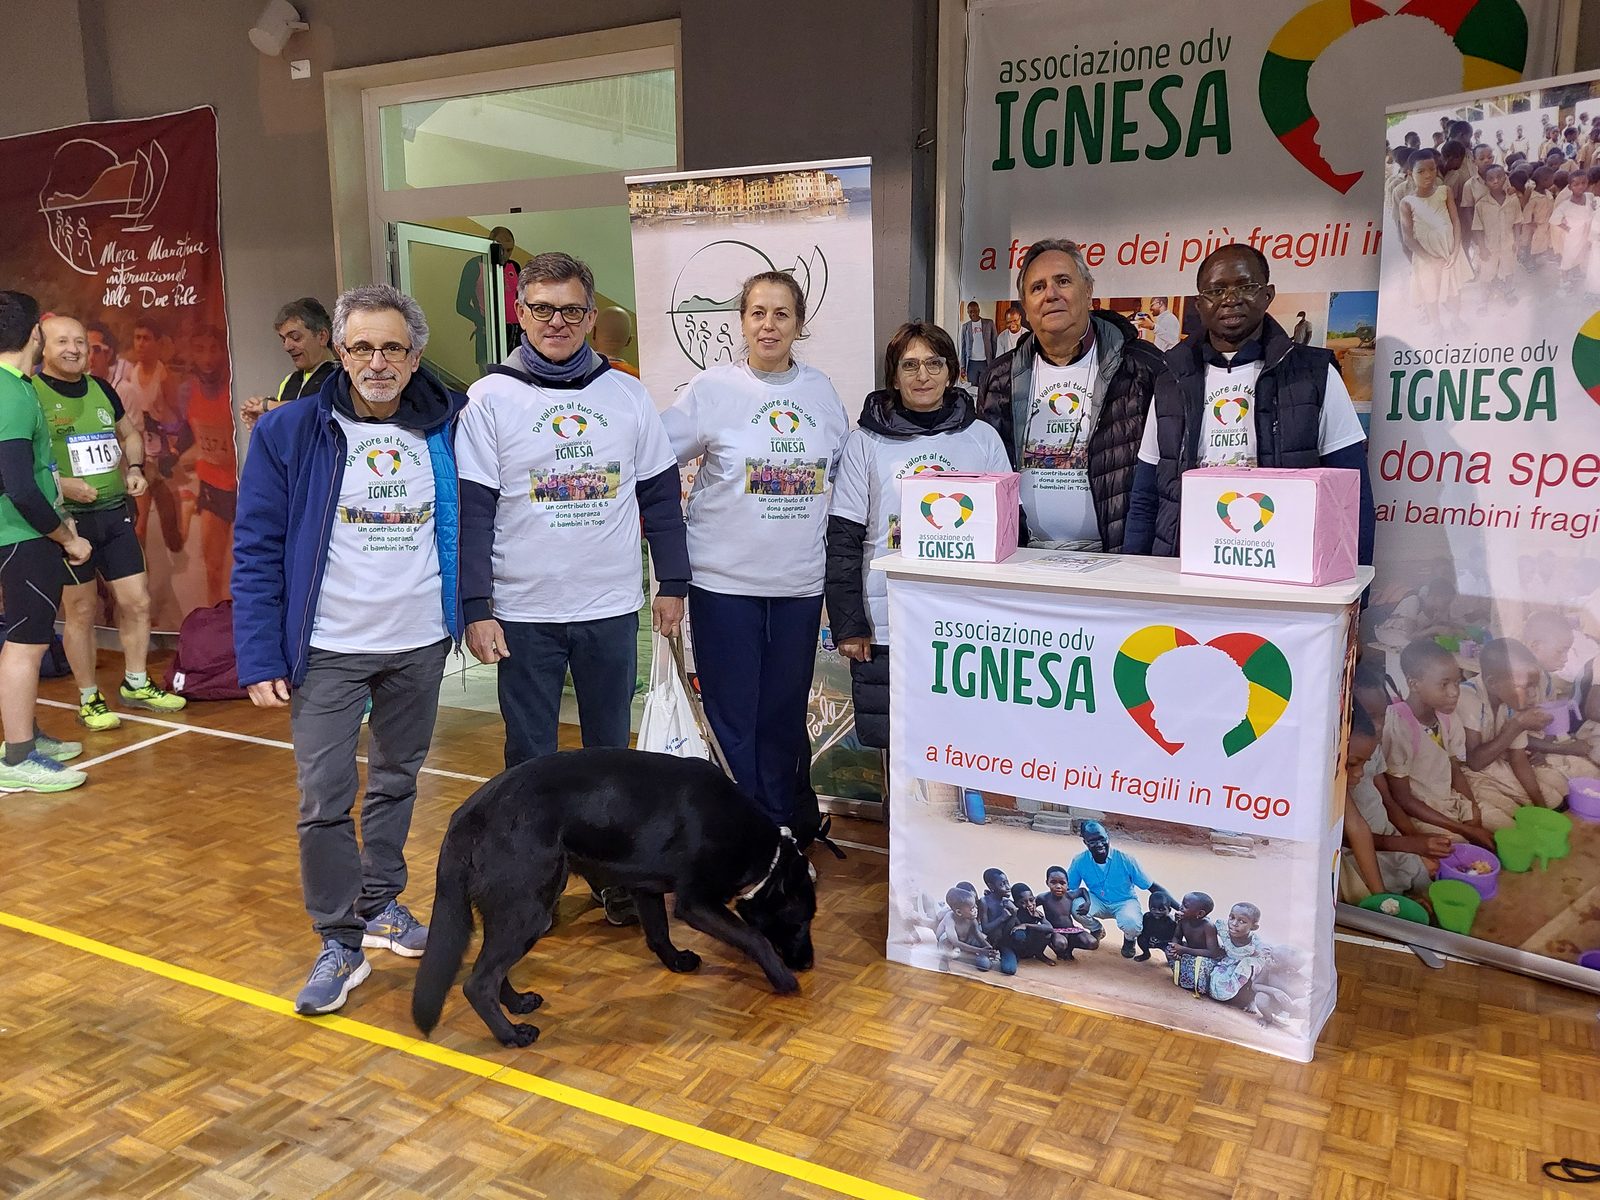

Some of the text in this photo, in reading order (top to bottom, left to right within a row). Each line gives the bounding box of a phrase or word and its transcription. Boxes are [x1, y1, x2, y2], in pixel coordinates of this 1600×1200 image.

[1000, 28, 1232, 84] associazione odv
[992, 70, 1232, 171] IGNESA
[979, 247, 997, 271] a
[1117, 232, 1170, 266] dei
[1248, 222, 1351, 268] fragili
[139, 286, 169, 308] Due
[1393, 339, 1558, 366] associazione odv
[1031, 398, 1041, 408] Da
[1040, 382, 1061, 398] valore
[1073, 383, 1087, 393] tuo
[1204, 386, 1229, 405] valore
[1232, 383, 1241, 391] al
[1386, 366, 1558, 422] IGNESA
[532, 401, 608, 433] Da valore al tuo chip
[751, 399, 817, 428] Da valore al tuo chip
[353, 437, 382, 454] valore
[384, 435, 393, 444] al
[396, 437, 409, 451] tuo
[407, 450, 421, 466] chip
[555, 445, 594, 461] IGNESA
[771, 441, 806, 453] IGNESA
[1210, 432, 1249, 447] IGNESA
[86, 443, 112, 464] 116
[895, 452, 951, 480] Da valore al tuo
[1380, 440, 1491, 484] dona
[367, 485, 407, 499] IGNESA
[573, 511, 601, 519] speranza
[1375, 500, 1397, 522] ai
[1405, 500, 1521, 529] bambini
[918, 540, 975, 560] IGNESA
[919, 532, 974, 542] associazione odv
[1214, 537, 1275, 548] associazione odv
[1213, 545, 1276, 569] IGNESA
[934, 619, 1095, 652] associazione odv
[931, 640, 1096, 714] IGNESA
[926, 744, 1291, 820] a favore dei più fragili in Togo
